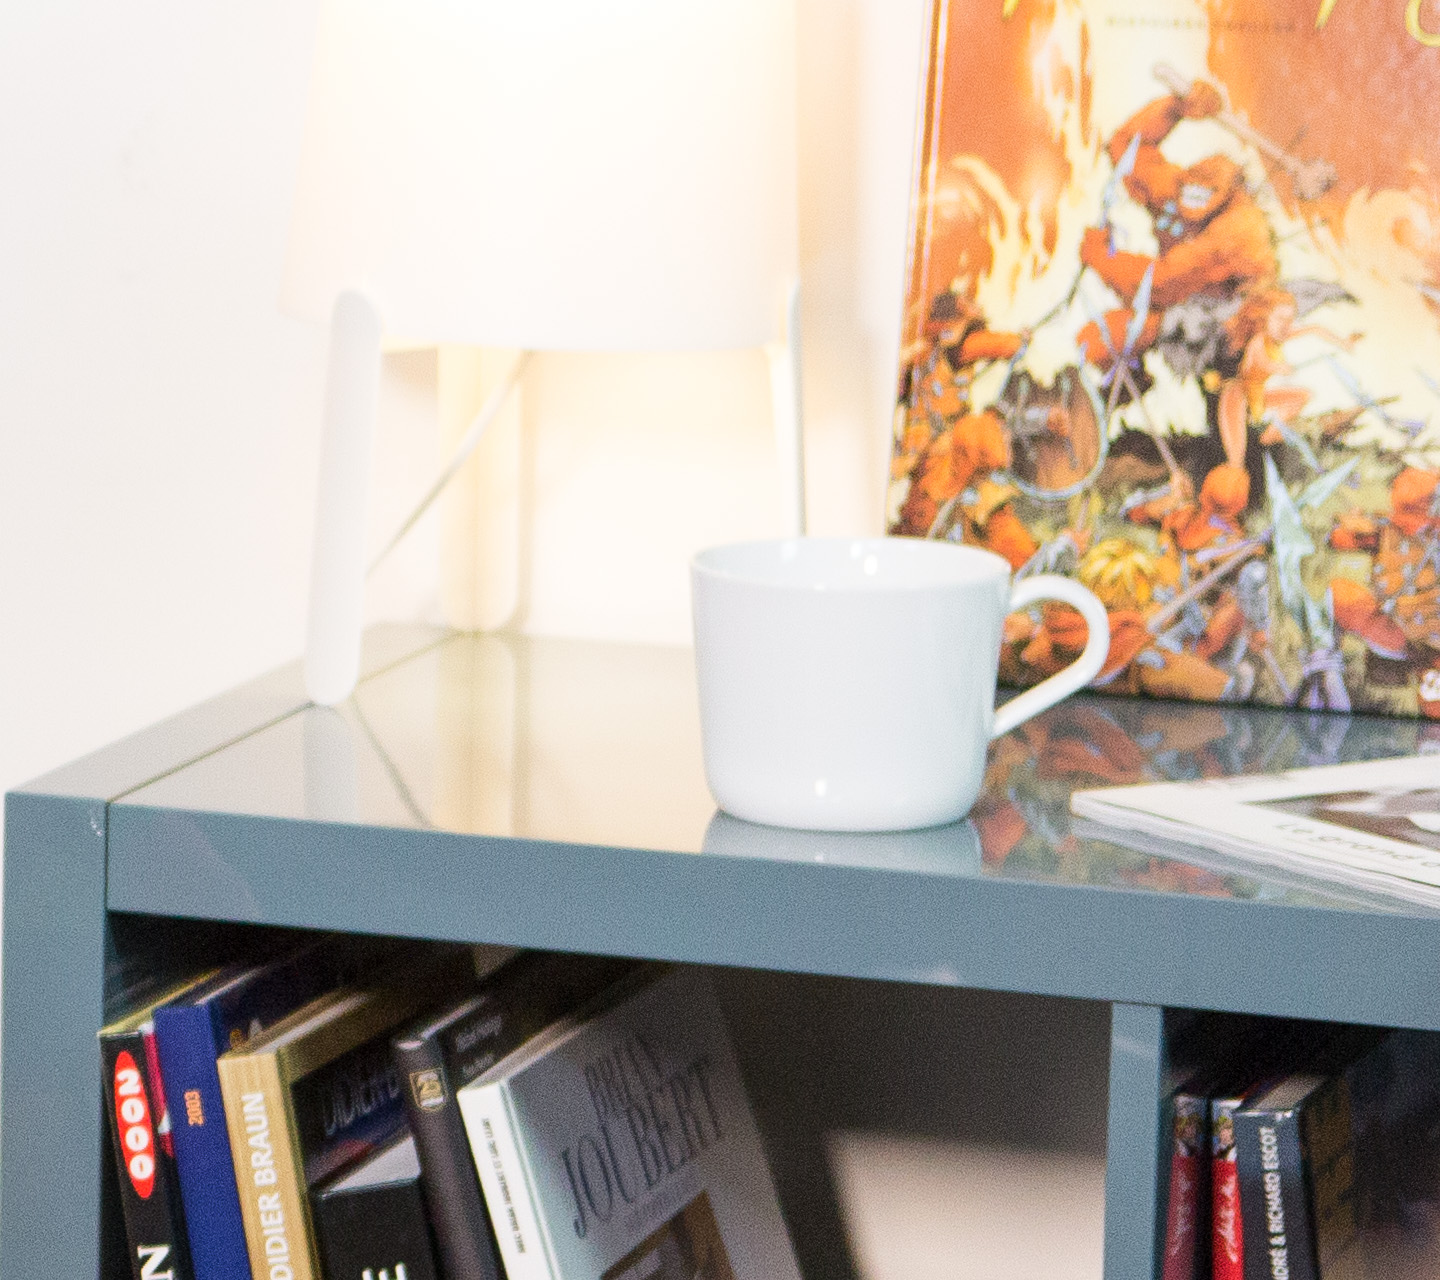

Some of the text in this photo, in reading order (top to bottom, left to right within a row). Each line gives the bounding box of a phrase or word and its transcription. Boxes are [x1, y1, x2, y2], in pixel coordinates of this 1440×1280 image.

[116, 1068, 155, 1181] 2000
[184, 1089, 204, 1127] 2003
[241, 1092, 278, 1187] BRAUN
[560, 1060, 723, 1239] JOUBERT
[1259, 1125, 1278, 1168] ESCOT
[1264, 1171, 1285, 1232] RICHARD
[1270, 1233, 1286, 1246] &
